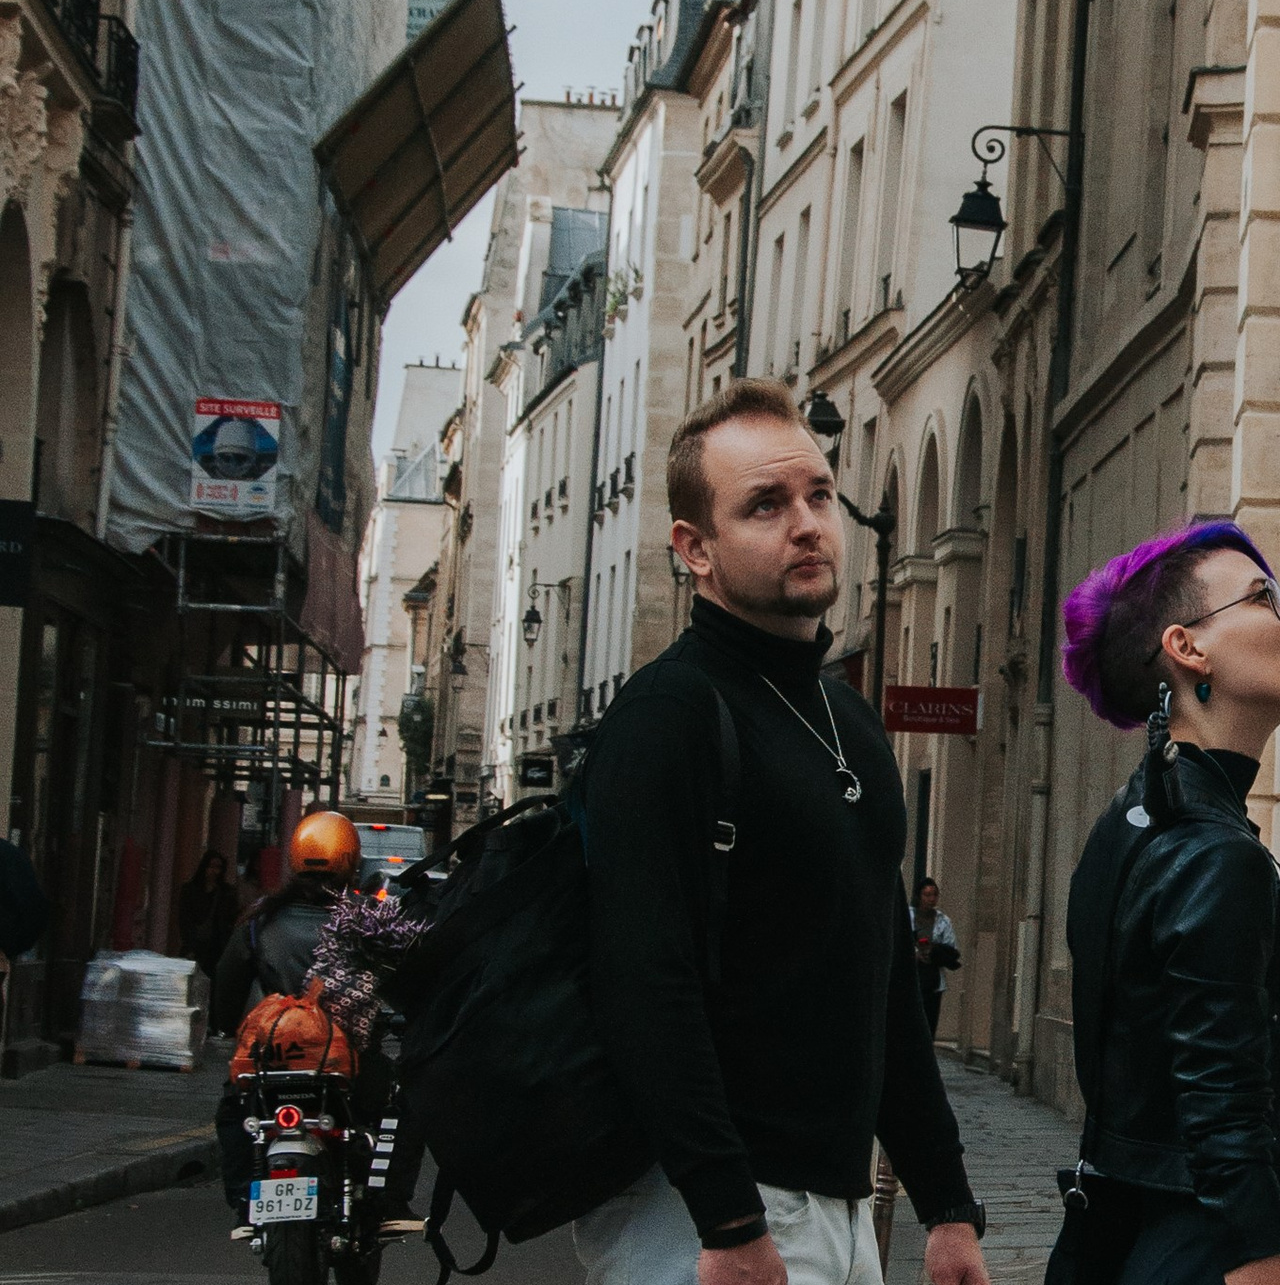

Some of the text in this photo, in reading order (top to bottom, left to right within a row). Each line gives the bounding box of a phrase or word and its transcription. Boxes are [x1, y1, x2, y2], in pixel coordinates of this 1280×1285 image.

[200, 402, 221, 412] SITE
[888, 701, 974, 716] CLARINS
[277, 1092, 317, 1100] HONDA
[255, 1197, 313, 1213] 961-DZ
